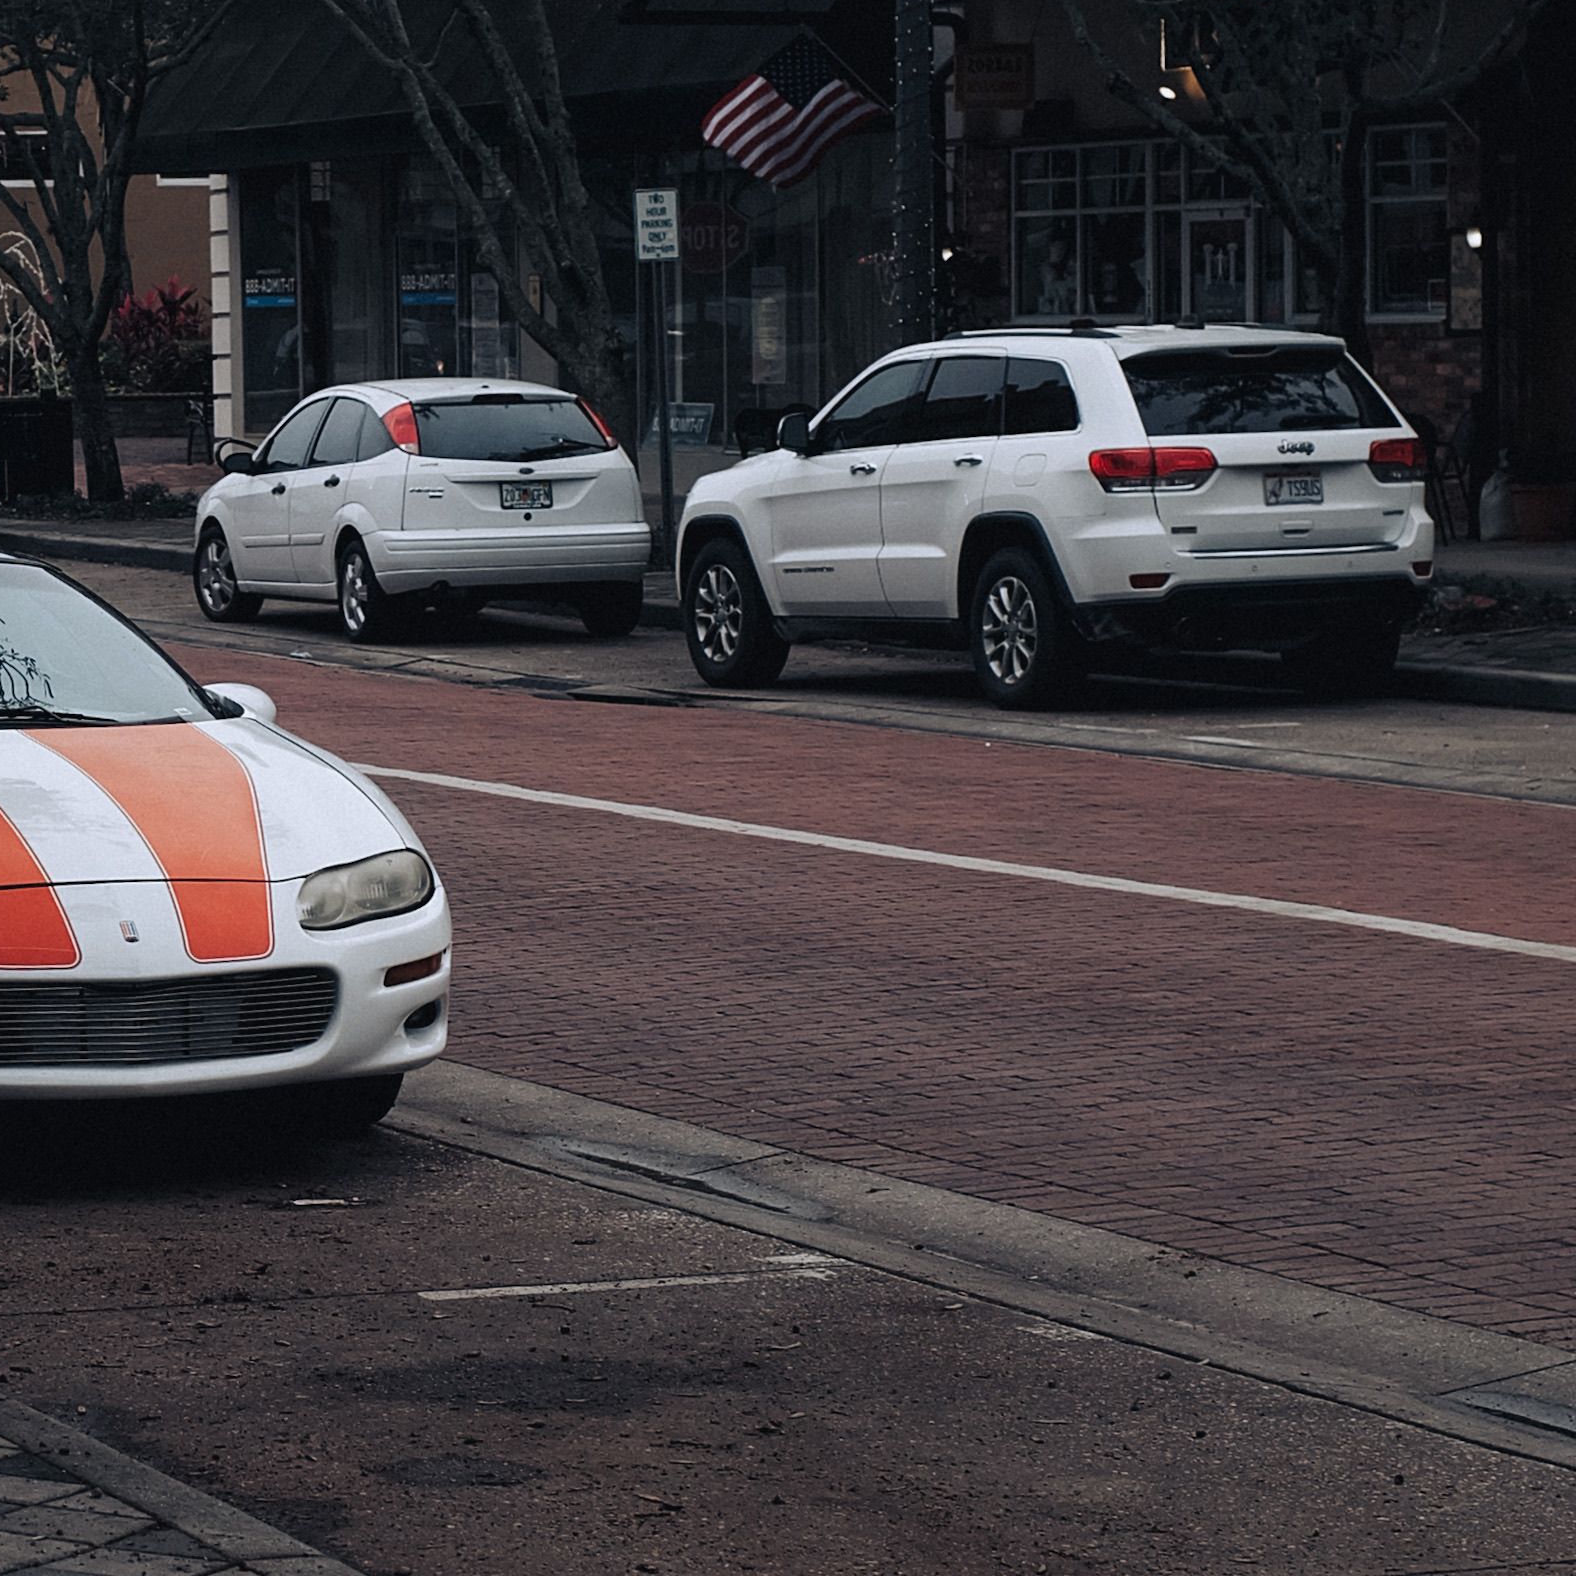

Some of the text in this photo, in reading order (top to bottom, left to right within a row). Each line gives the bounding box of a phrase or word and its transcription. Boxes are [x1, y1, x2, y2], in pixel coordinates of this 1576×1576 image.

[648, 193, 665, 204] TWO
[646, 206, 667, 217] HOUR
[641, 218, 673, 229] PARKING
[648, 231, 666, 243] ONLY
[1278, 439, 1315, 456] Jeep
